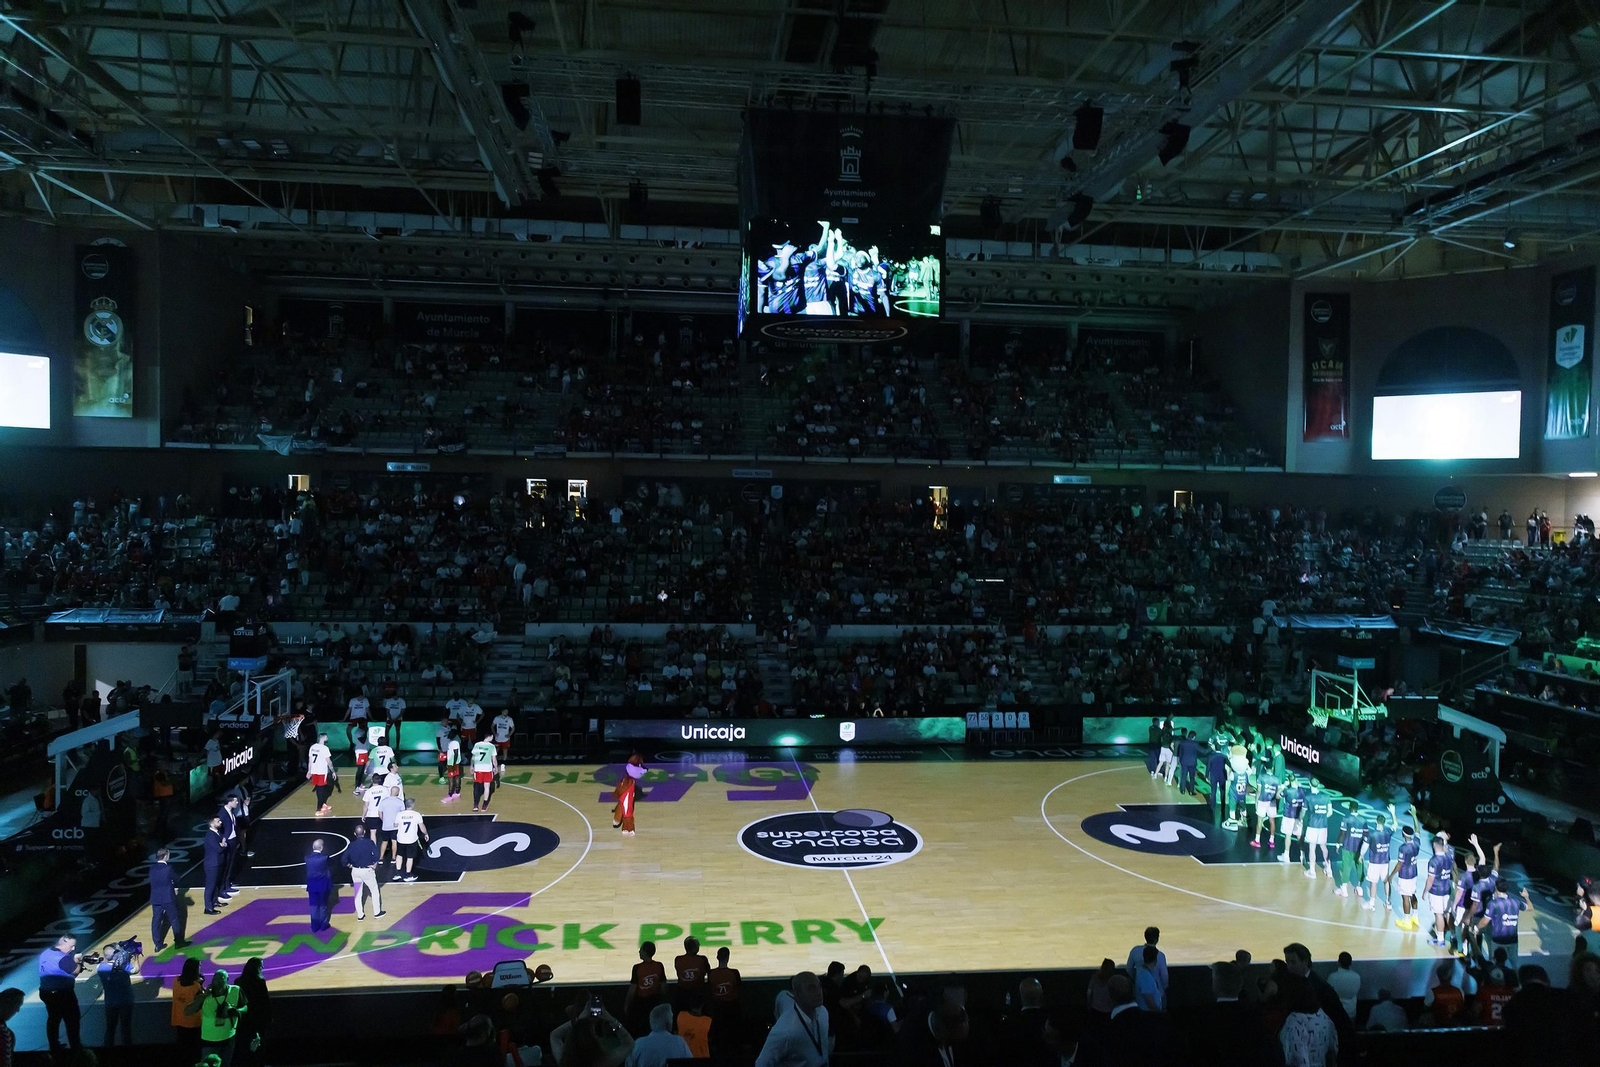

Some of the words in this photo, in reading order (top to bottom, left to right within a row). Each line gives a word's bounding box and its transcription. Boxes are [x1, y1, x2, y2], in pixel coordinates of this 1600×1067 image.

[824, 188, 877, 198] Ayuntamiento
[831, 199, 841, 208] de
[842, 200, 869, 208] Murcia
[416, 311, 491, 323] Ayuntamiento
[427, 326, 440, 337] de
[443, 327, 479, 338] Murcia
[1312, 360, 1344, 371] UCAM
[109, 396, 126, 404] acb
[980, 713, 989, 721] 55
[1022, 713, 1027, 721] 2
[681, 724, 747, 742] Unicaja
[989, 747, 1150, 758] endesa
[1280, 734, 1320, 764] Unicaja
[312, 753, 318, 764] 7
[378, 755, 386, 766] 7
[479, 752, 487, 762] 7
[1471, 771, 1488, 779] acb
[75, 789, 89, 797] ac
[373, 796, 382, 807] 7
[1475, 802, 1500, 814] acb
[52, 827, 85, 839] acb
[403, 822, 411, 833] 7
[756, 829, 897, 840] supercopa
[771, 836, 904, 848] endesa
[152, 923, 619, 964] KENDRICK
[638, 918, 886, 949] PERRY
